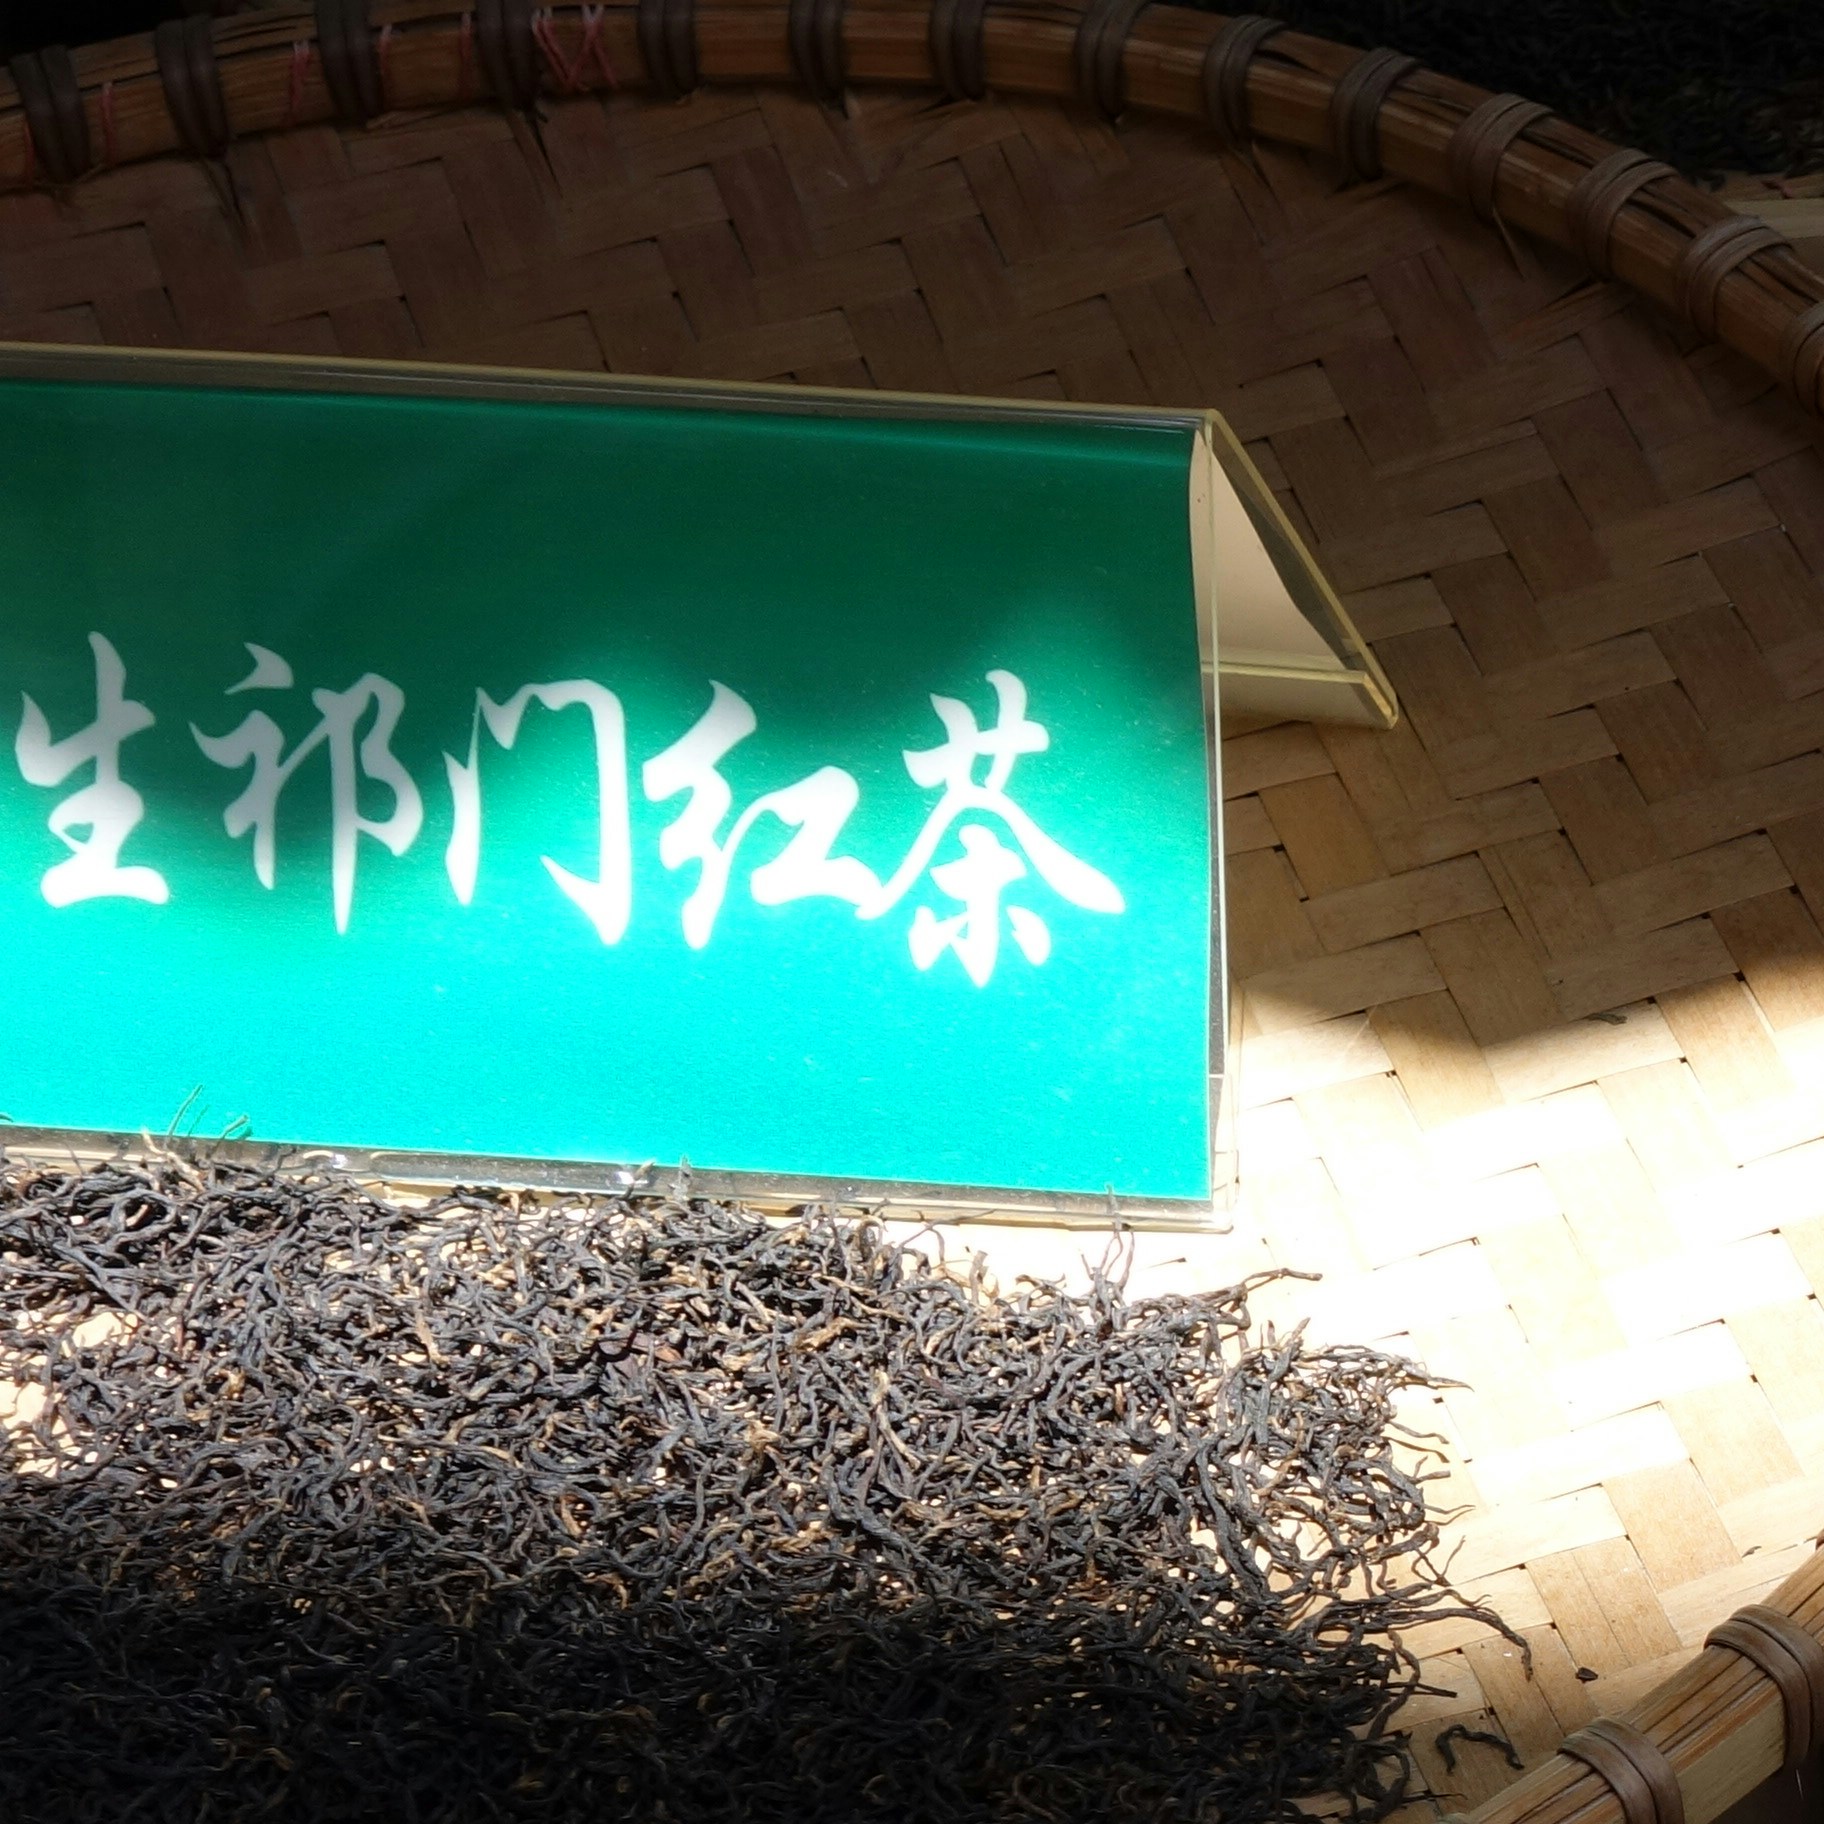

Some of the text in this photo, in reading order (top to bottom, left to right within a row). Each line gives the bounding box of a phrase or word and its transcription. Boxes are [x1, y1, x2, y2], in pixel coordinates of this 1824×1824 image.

[14, 630, 1127, 988] 生祁门红茶
